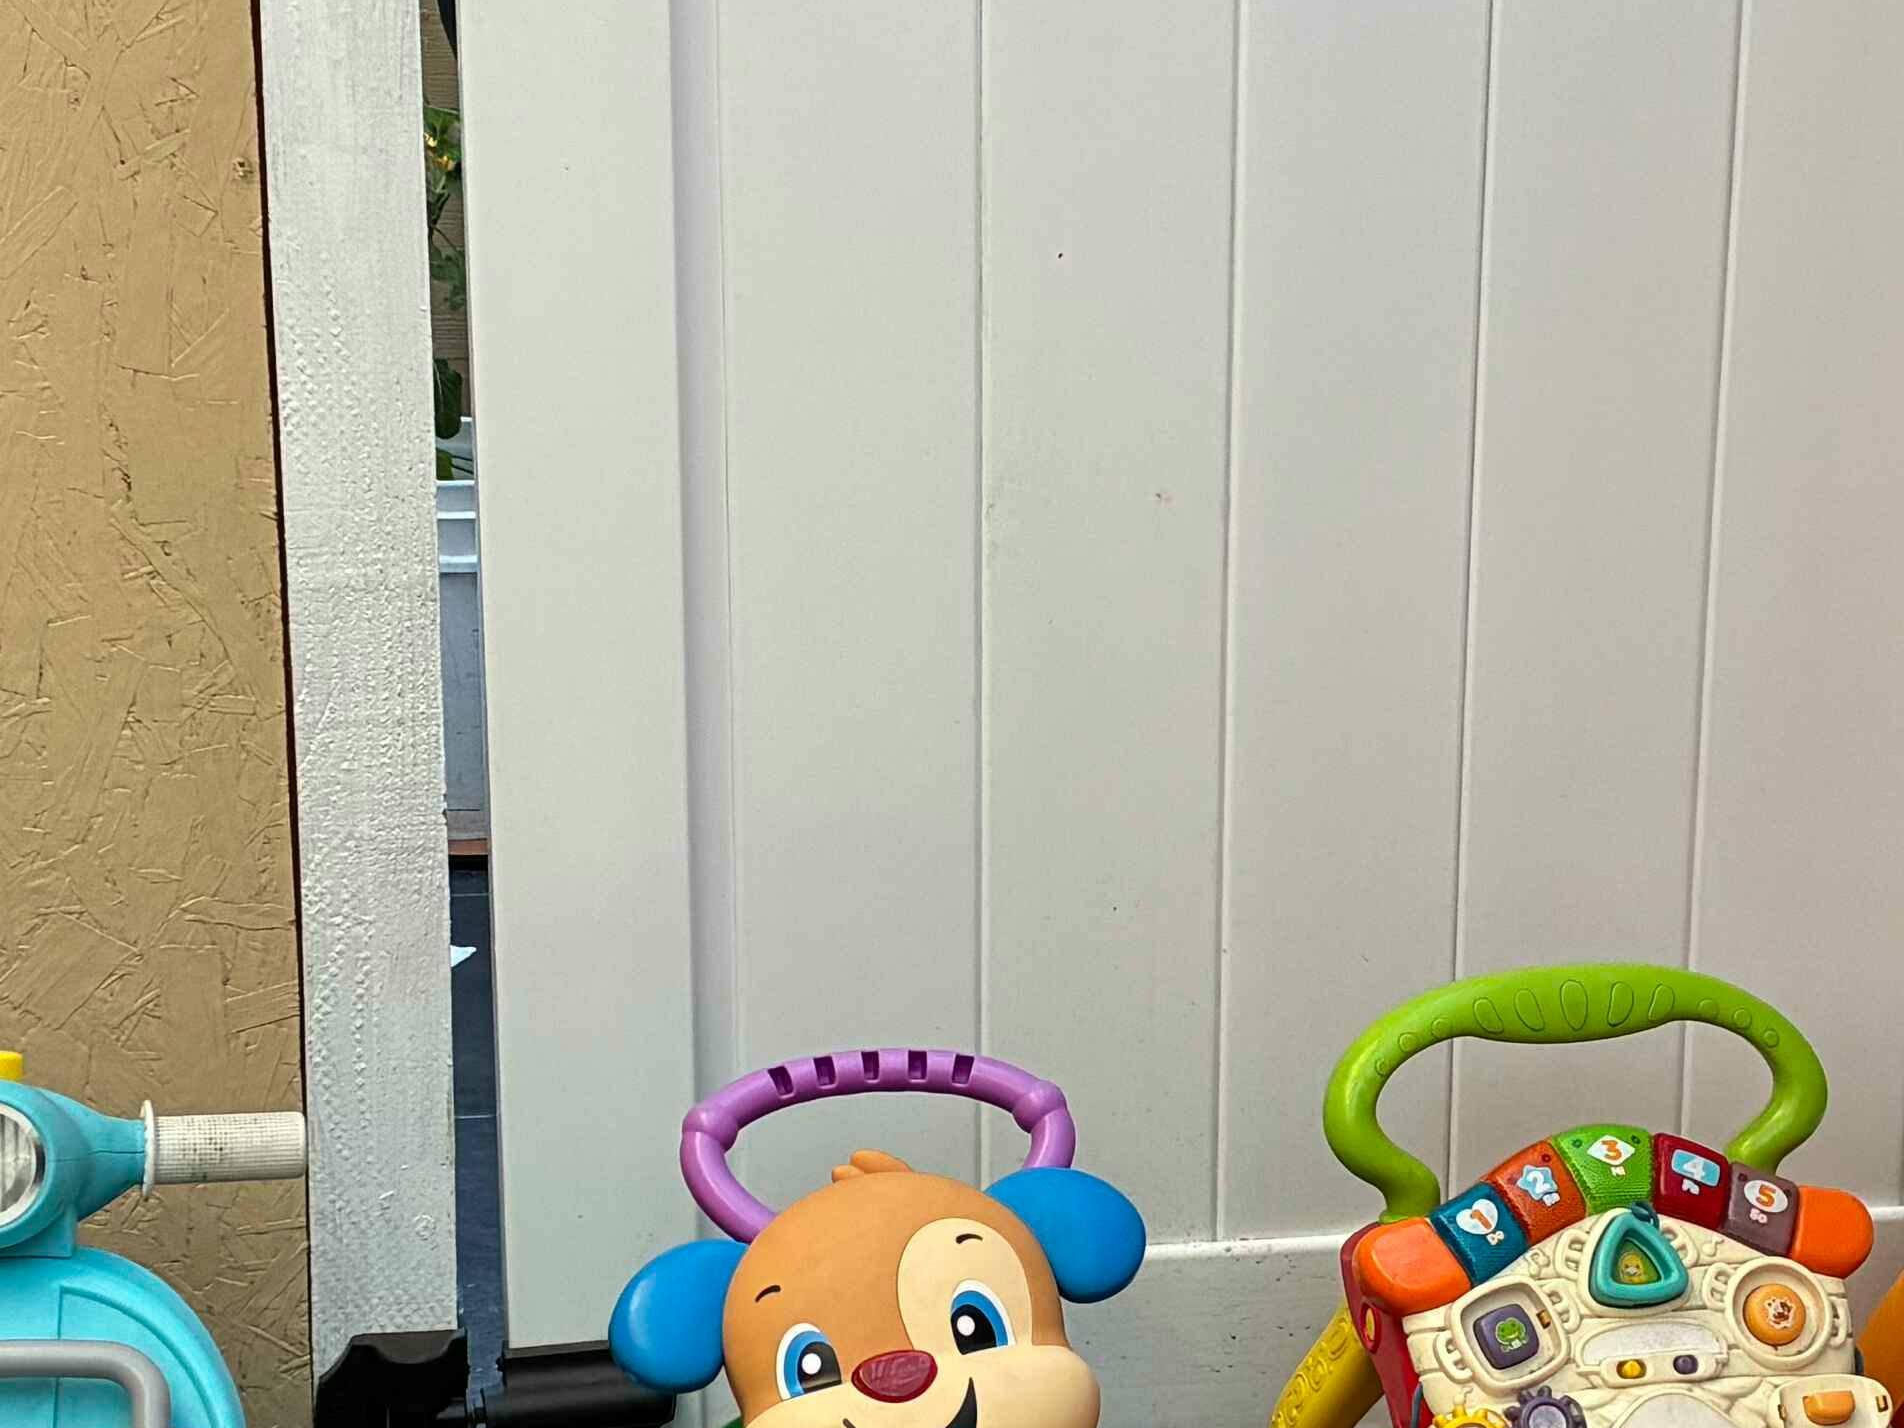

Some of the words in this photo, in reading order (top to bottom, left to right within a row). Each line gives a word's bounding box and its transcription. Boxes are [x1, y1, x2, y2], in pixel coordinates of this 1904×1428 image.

[1600, 1139, 1622, 1160] 3
[1683, 1158, 1706, 1180] 4
[1526, 1170, 1551, 1194] 2
[1756, 1184, 1777, 1207] 5
[1471, 1209, 1492, 1230] 1
